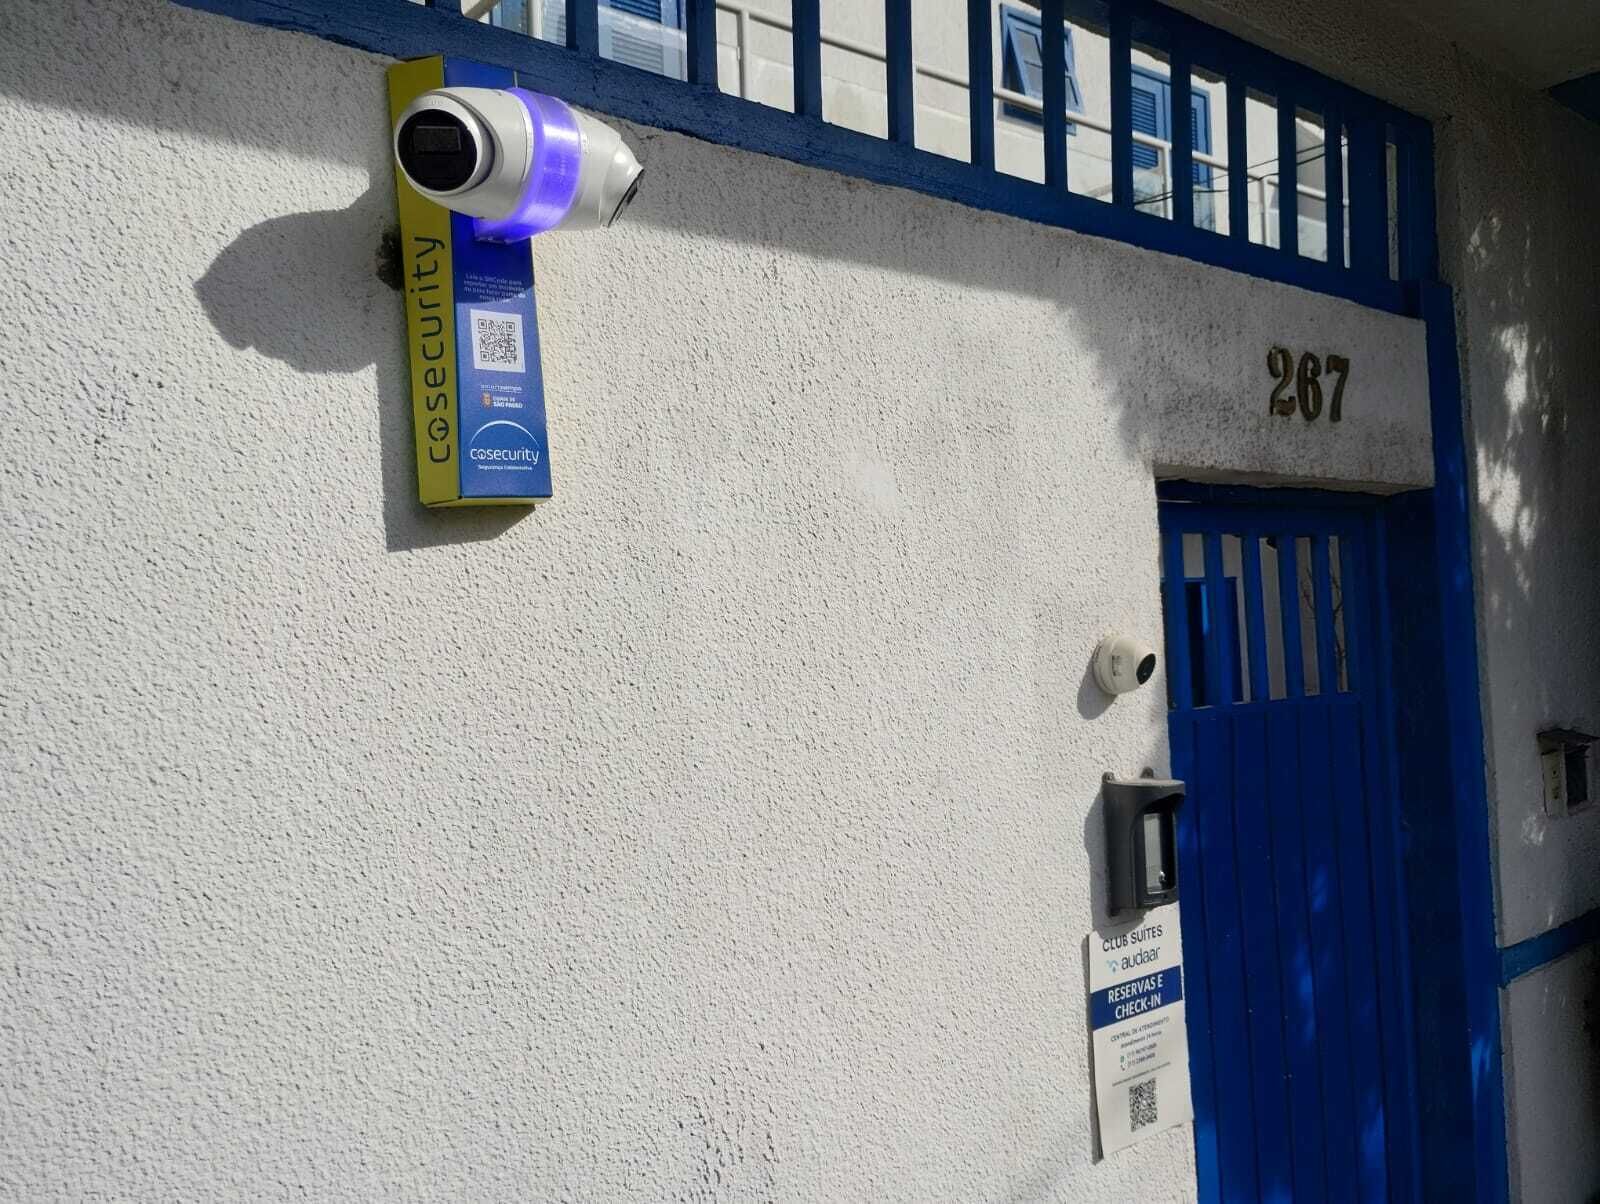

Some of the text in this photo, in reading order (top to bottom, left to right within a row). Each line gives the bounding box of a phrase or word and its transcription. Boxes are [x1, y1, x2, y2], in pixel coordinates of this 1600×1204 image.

[410, 236, 450, 463] cosecurity
[1266, 346, 1350, 422] 267
[470, 447, 539, 465] cosecurity
[1102, 933, 1129, 952] CLUB
[1121, 946, 1161, 970] audaar
[1108, 974, 1164, 1004] RESERVAS E
[1115, 992, 1161, 1019] CHECK-IN
